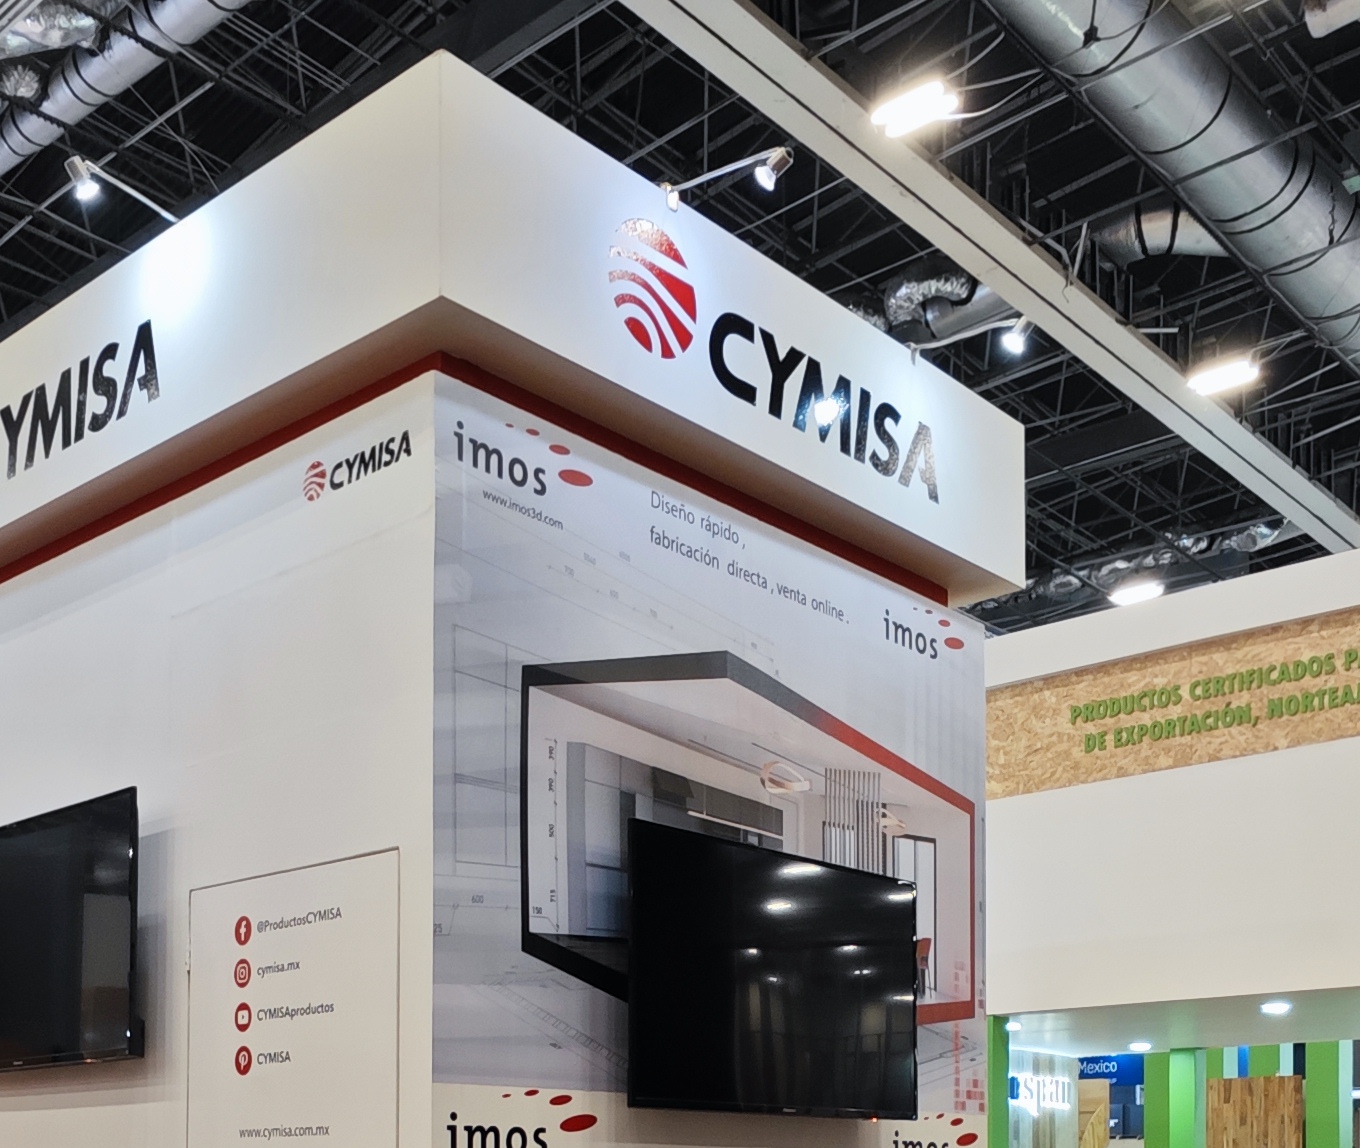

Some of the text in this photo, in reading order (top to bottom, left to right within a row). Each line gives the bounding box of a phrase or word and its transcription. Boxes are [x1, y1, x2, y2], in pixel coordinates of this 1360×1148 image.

[709, 312, 939, 504] CYMISA
[329, 429, 412, 490] CYMISA
[453, 420, 547, 496] imos
[482, 488, 564, 531] www.imos3d.com
[650, 490, 695, 525] Diseño
[650, 525, 719, 571] fabricación
[776, 582, 807, 607] venta
[883, 609, 939, 660] imos
[1070, 685, 1182, 725] PRODUCTOS
[1189, 652, 1335, 701] CERTIFICADOS
[1084, 731, 1107, 754] DE
[1113, 702, 1261, 747] EXPORTACIÓN,
[257, 906, 343, 933] @ProductosCYMISA
[257, 961, 301, 979] cymisa.mx
[257, 1003, 335, 1022] CYMISAproductos
[257, 1051, 291, 1065] CYMISA
[1078, 1060, 1118, 1075] Mexico
[239, 1124, 330, 1141] www.cymisa.com.mx
